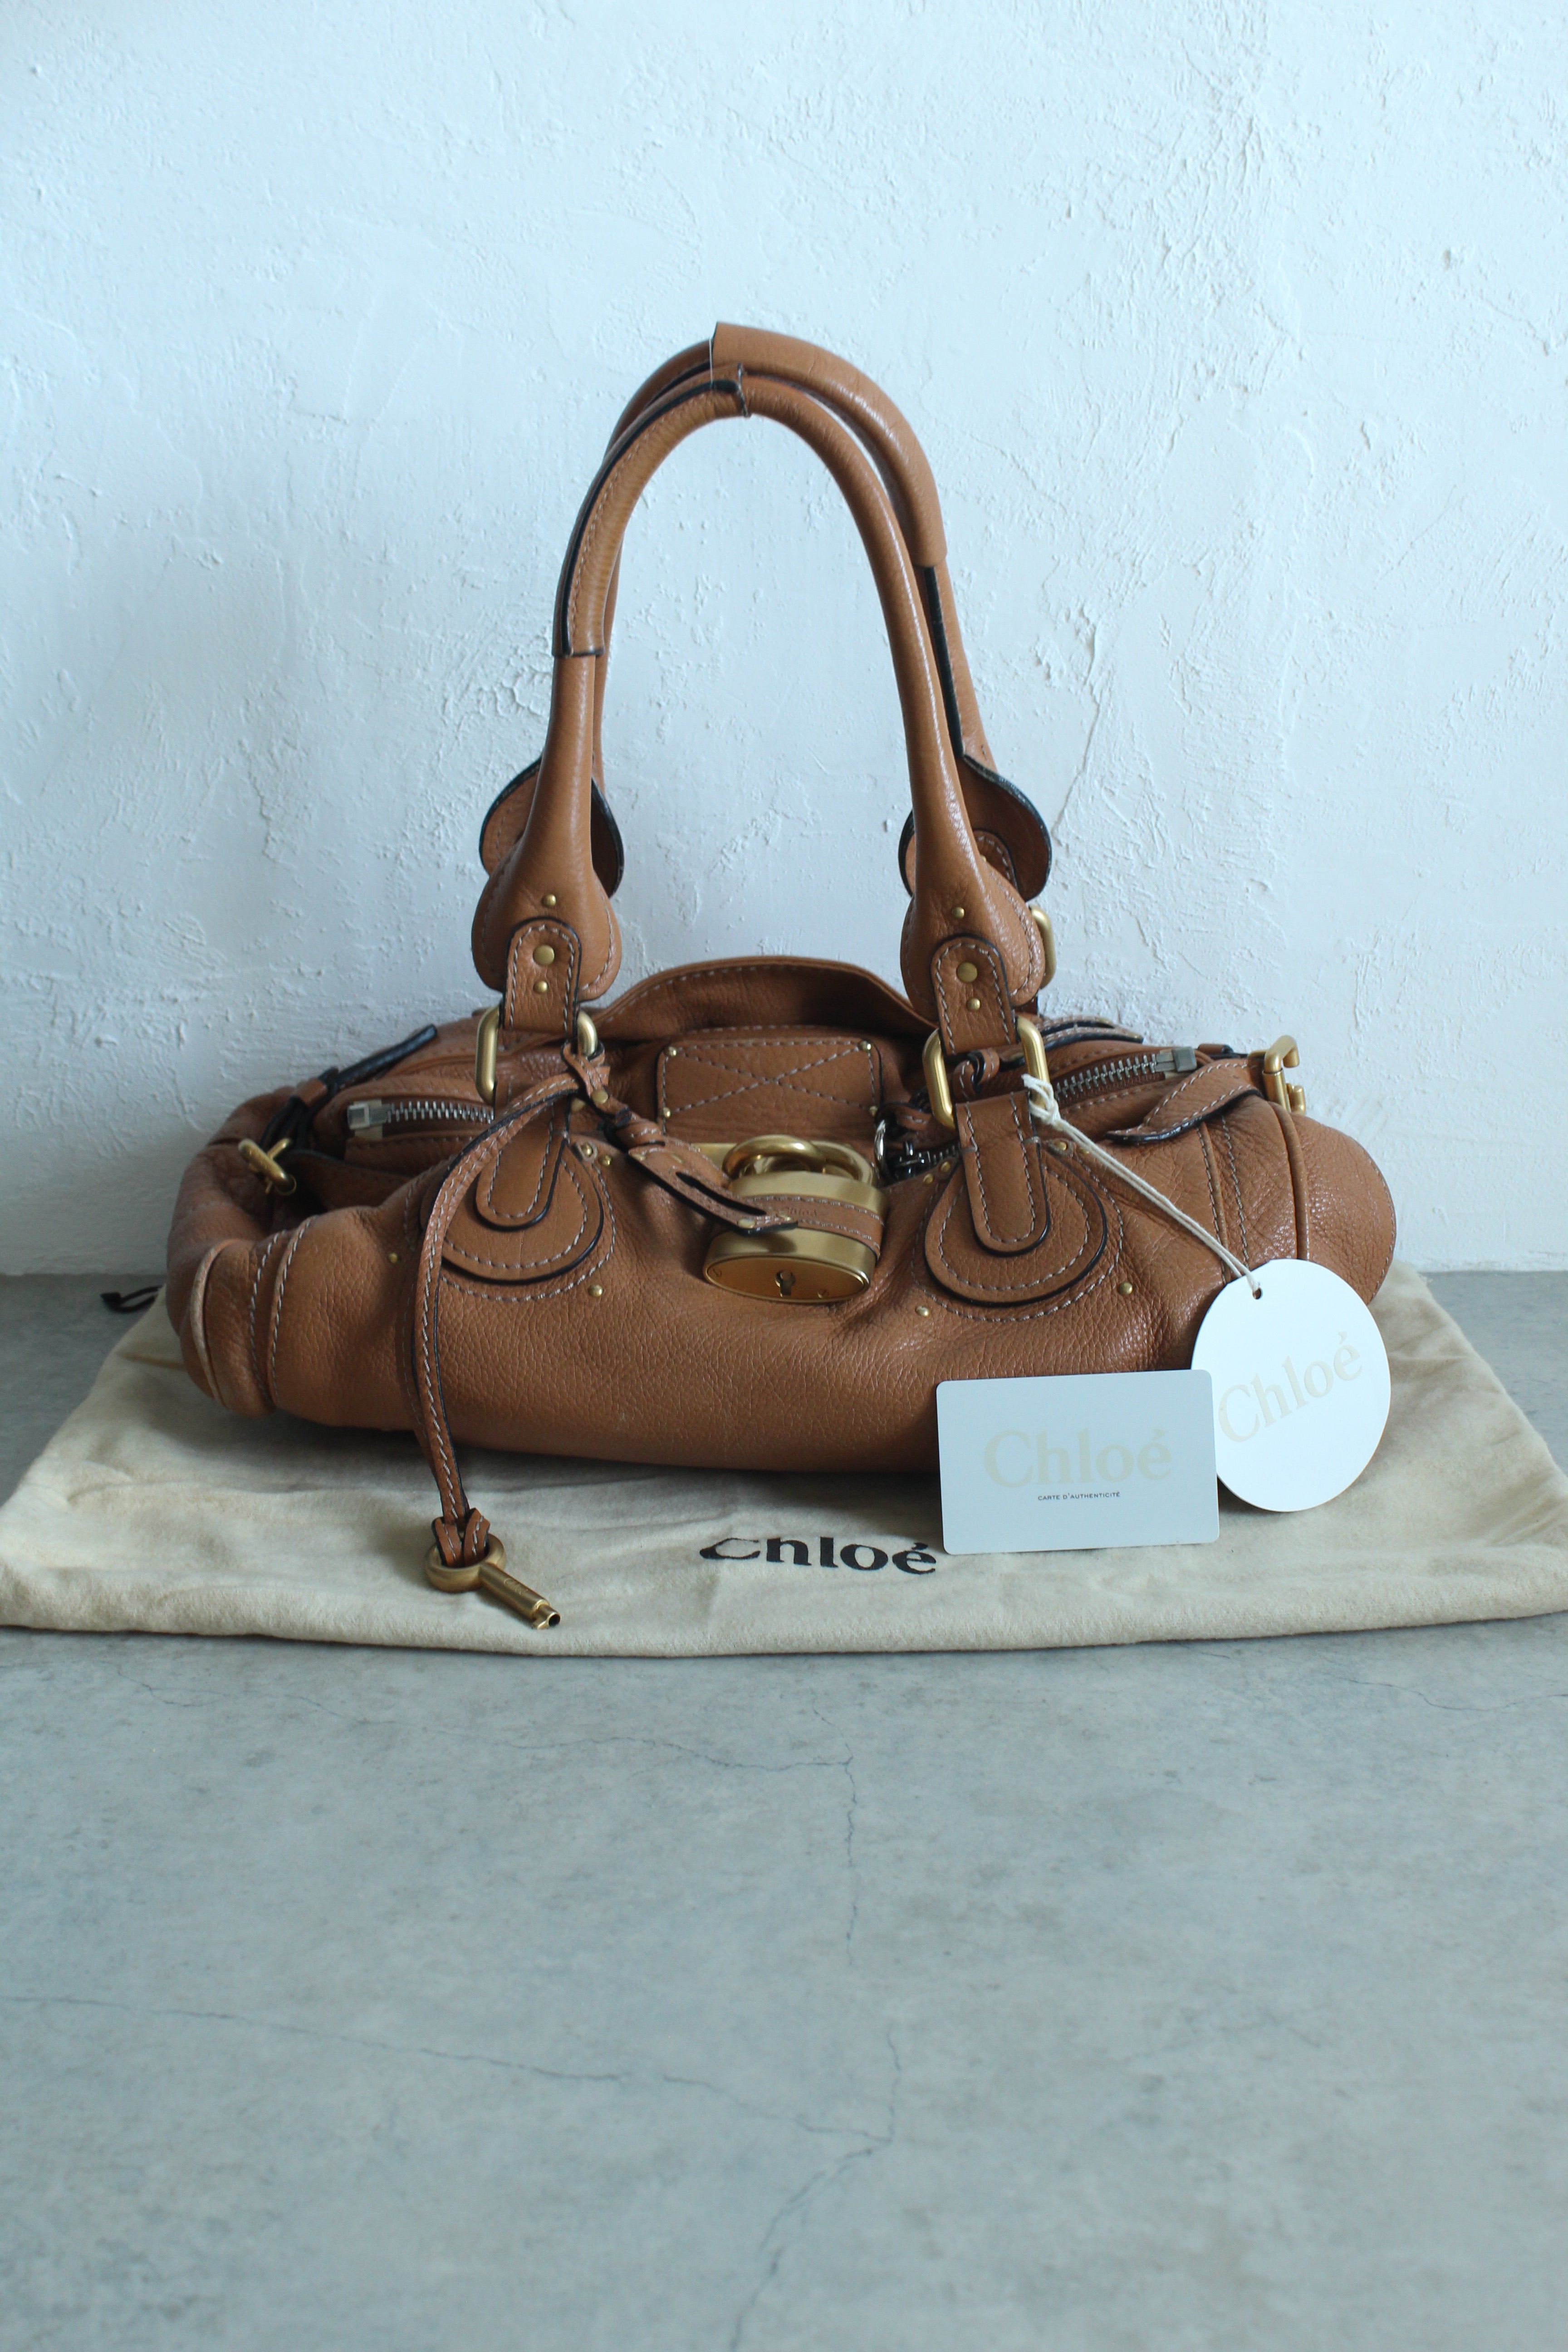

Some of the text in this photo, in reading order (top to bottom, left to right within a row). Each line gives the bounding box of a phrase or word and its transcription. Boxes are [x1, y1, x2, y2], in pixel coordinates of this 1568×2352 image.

[1218, 1331, 1363, 1442] Chloé
[983, 1426, 1172, 1488] Chloé
[1063, 1491, 1121, 1499] D'AUTHENTICITÉ
